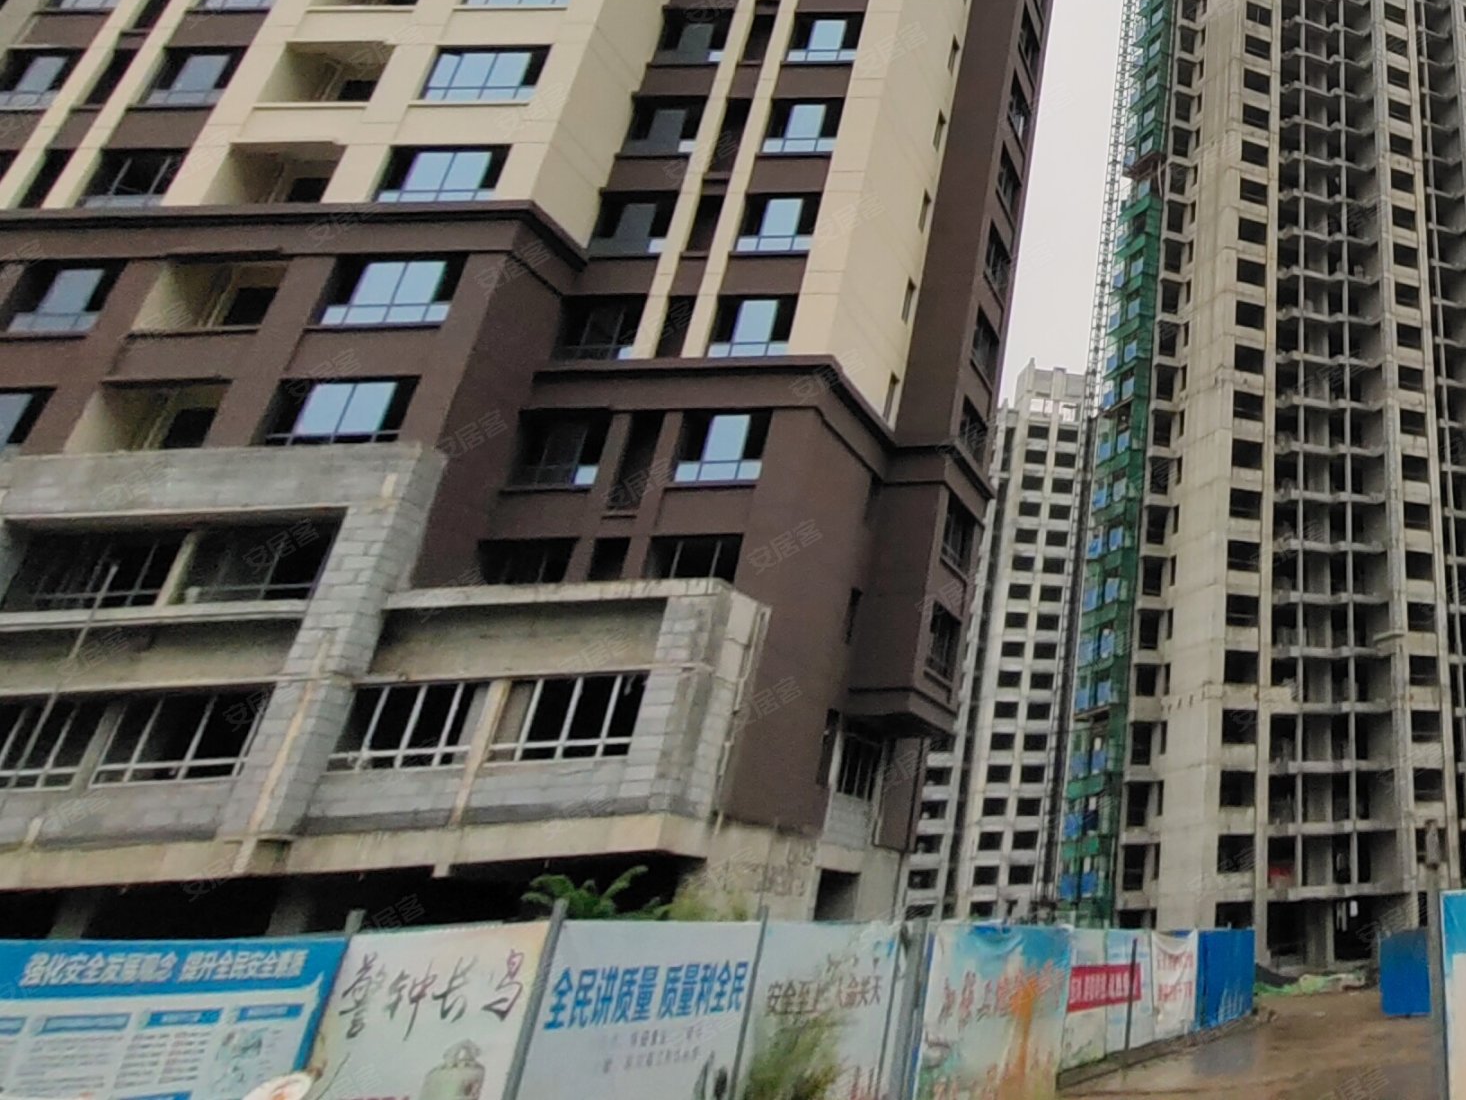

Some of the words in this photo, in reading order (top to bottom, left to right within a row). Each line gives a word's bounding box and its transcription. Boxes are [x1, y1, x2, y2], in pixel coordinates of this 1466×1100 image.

[543, 965, 660, 1030] 全民讲质量
